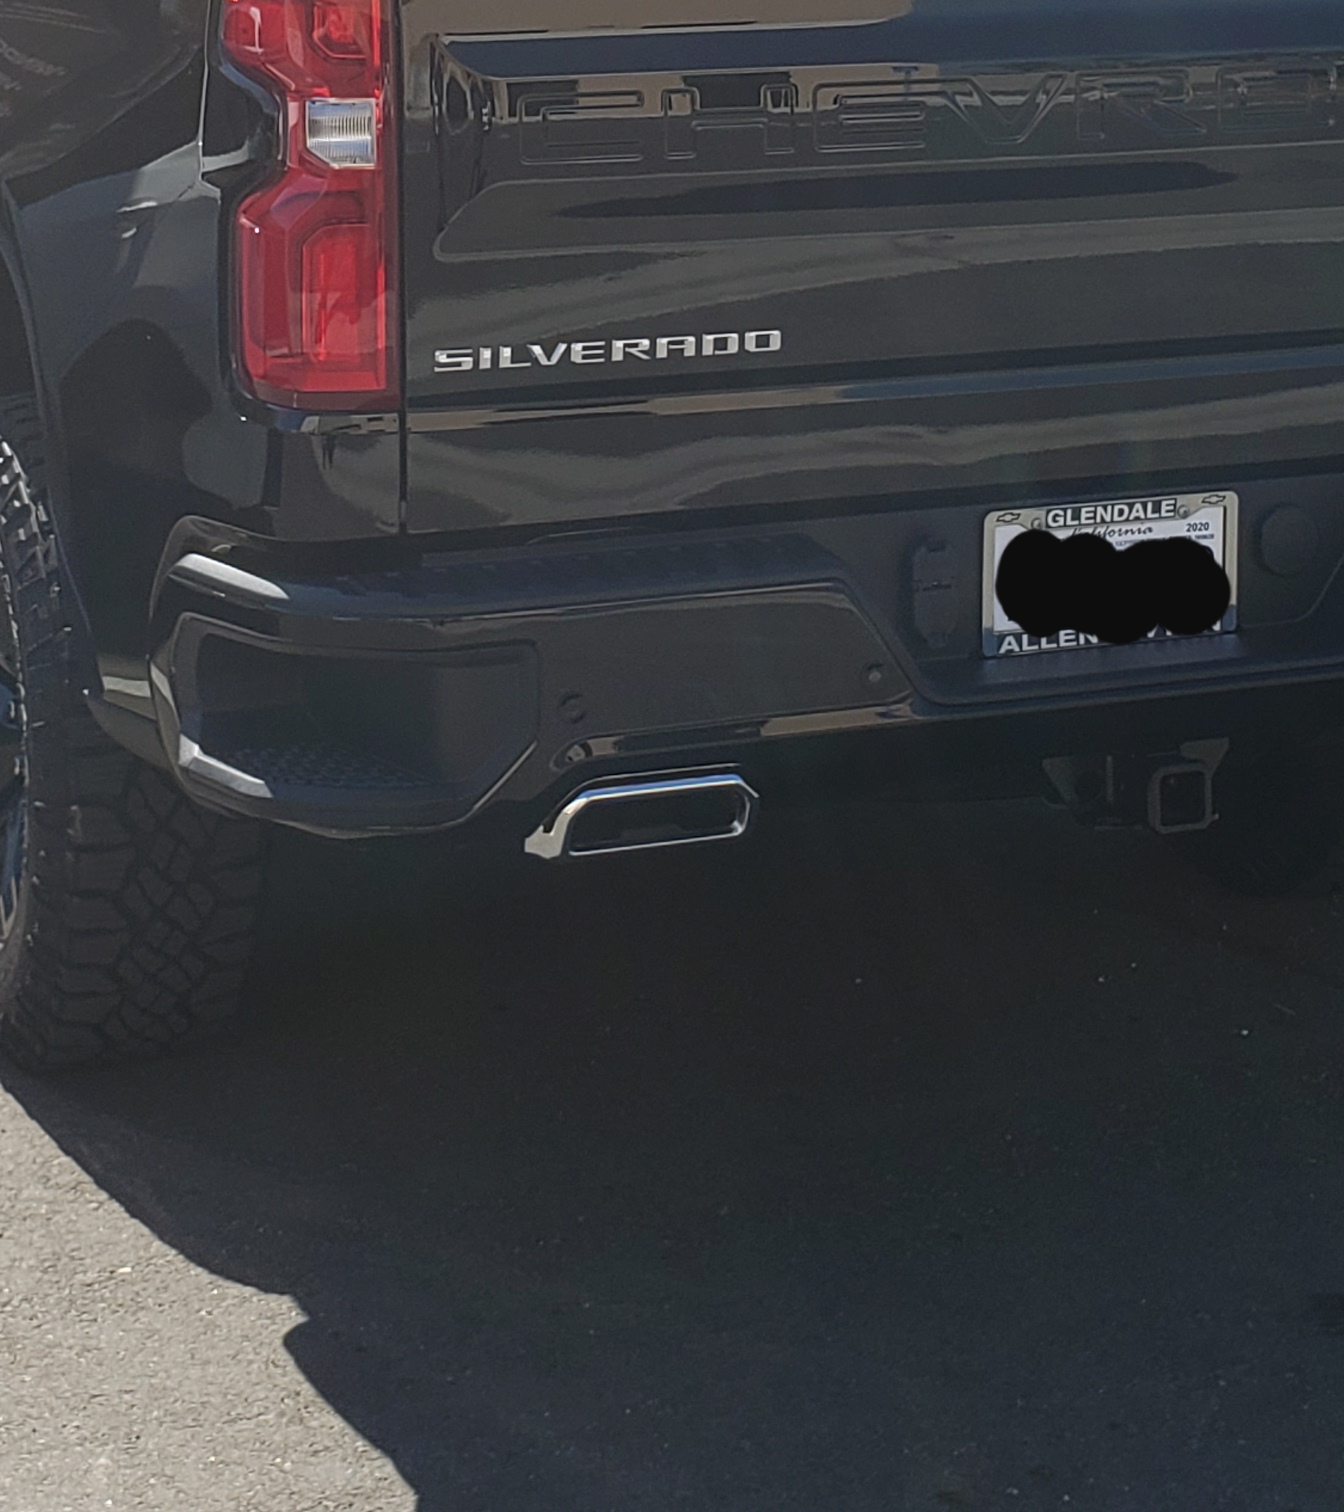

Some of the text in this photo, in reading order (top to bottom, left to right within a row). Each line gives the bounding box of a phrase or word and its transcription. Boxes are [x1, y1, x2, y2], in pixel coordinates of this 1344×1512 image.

[433, 329, 782, 373] SILVERADO
[1046, 500, 1176, 528] GLENDALE
[1185, 522, 1210, 533] 2020
